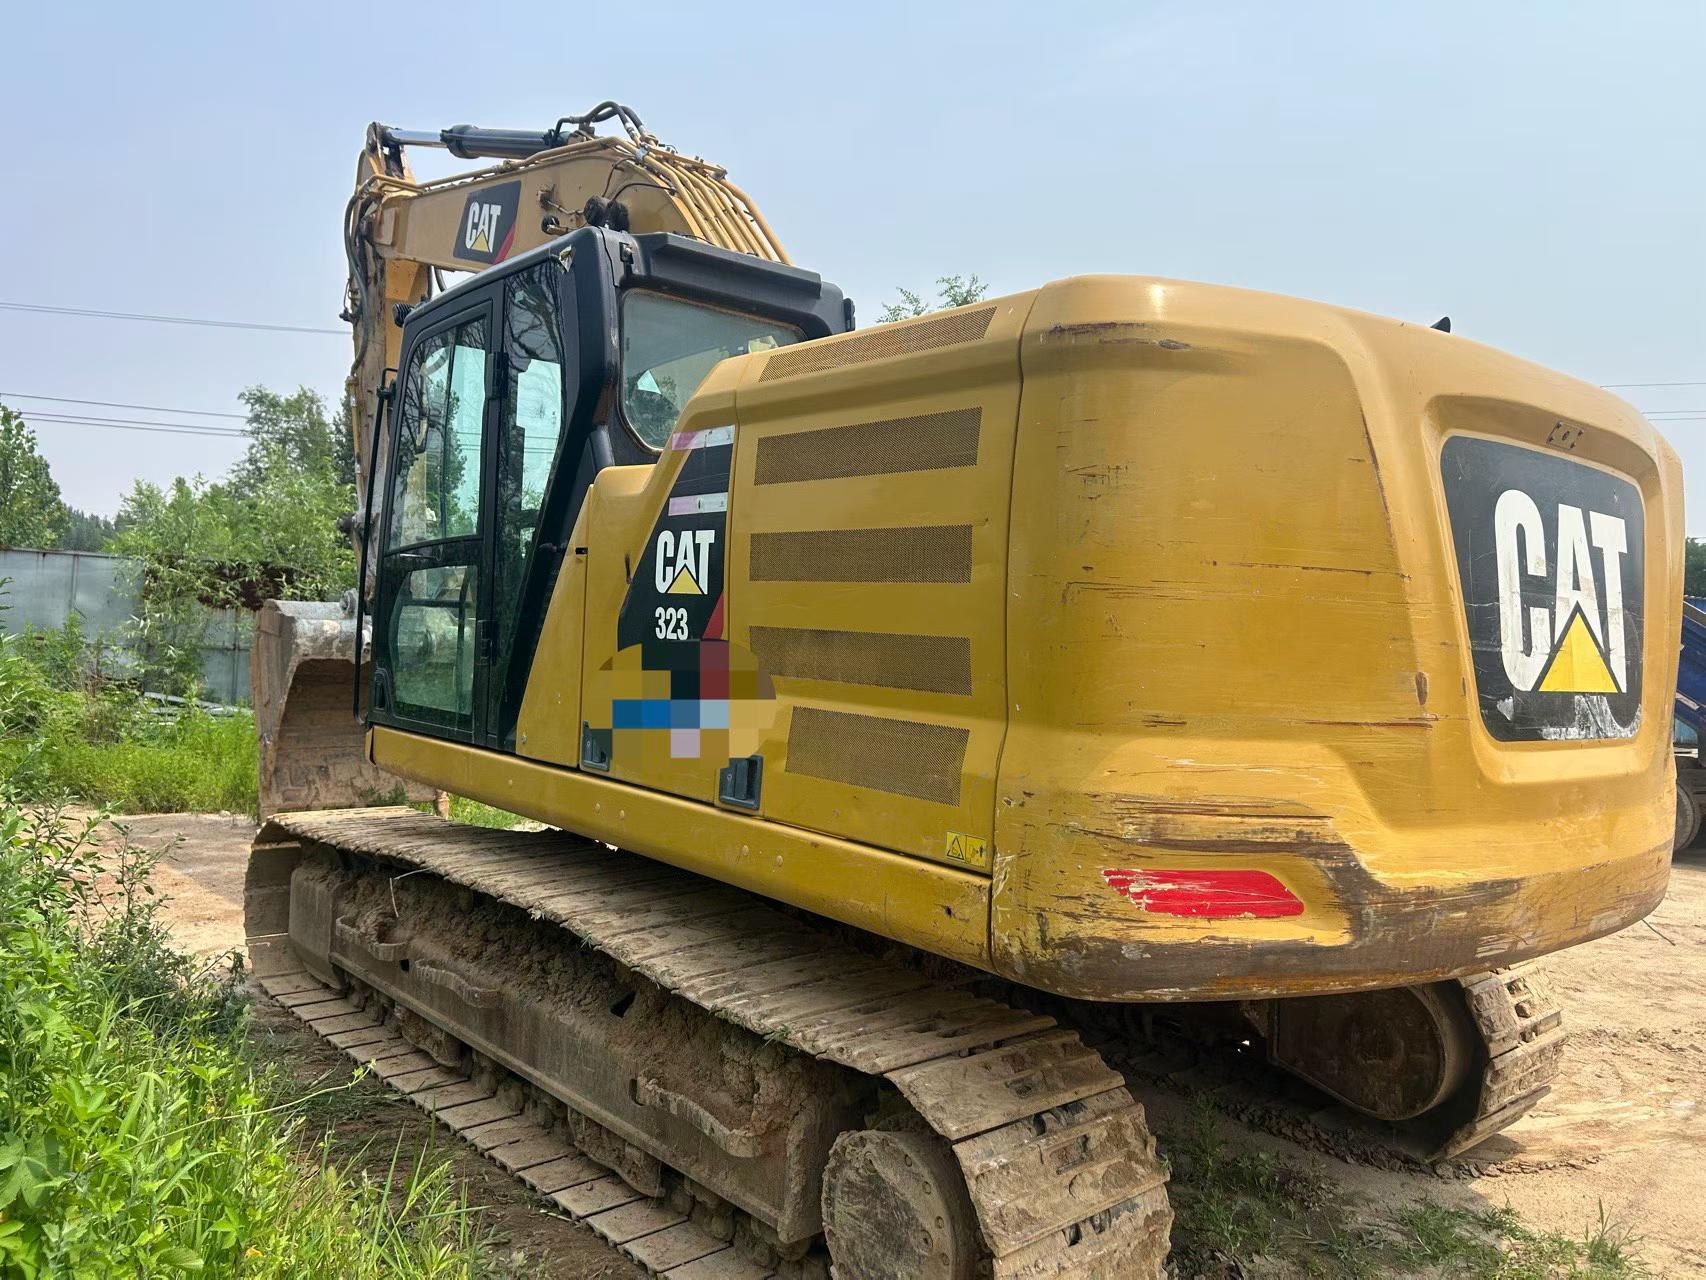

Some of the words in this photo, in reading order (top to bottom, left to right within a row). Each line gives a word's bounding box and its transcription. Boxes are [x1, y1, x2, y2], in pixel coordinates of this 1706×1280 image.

[465, 201, 502, 253] CAT
[655, 530, 715, 595] CAT
[1494, 489, 1628, 693] CAT
[655, 607, 688, 640] 323
